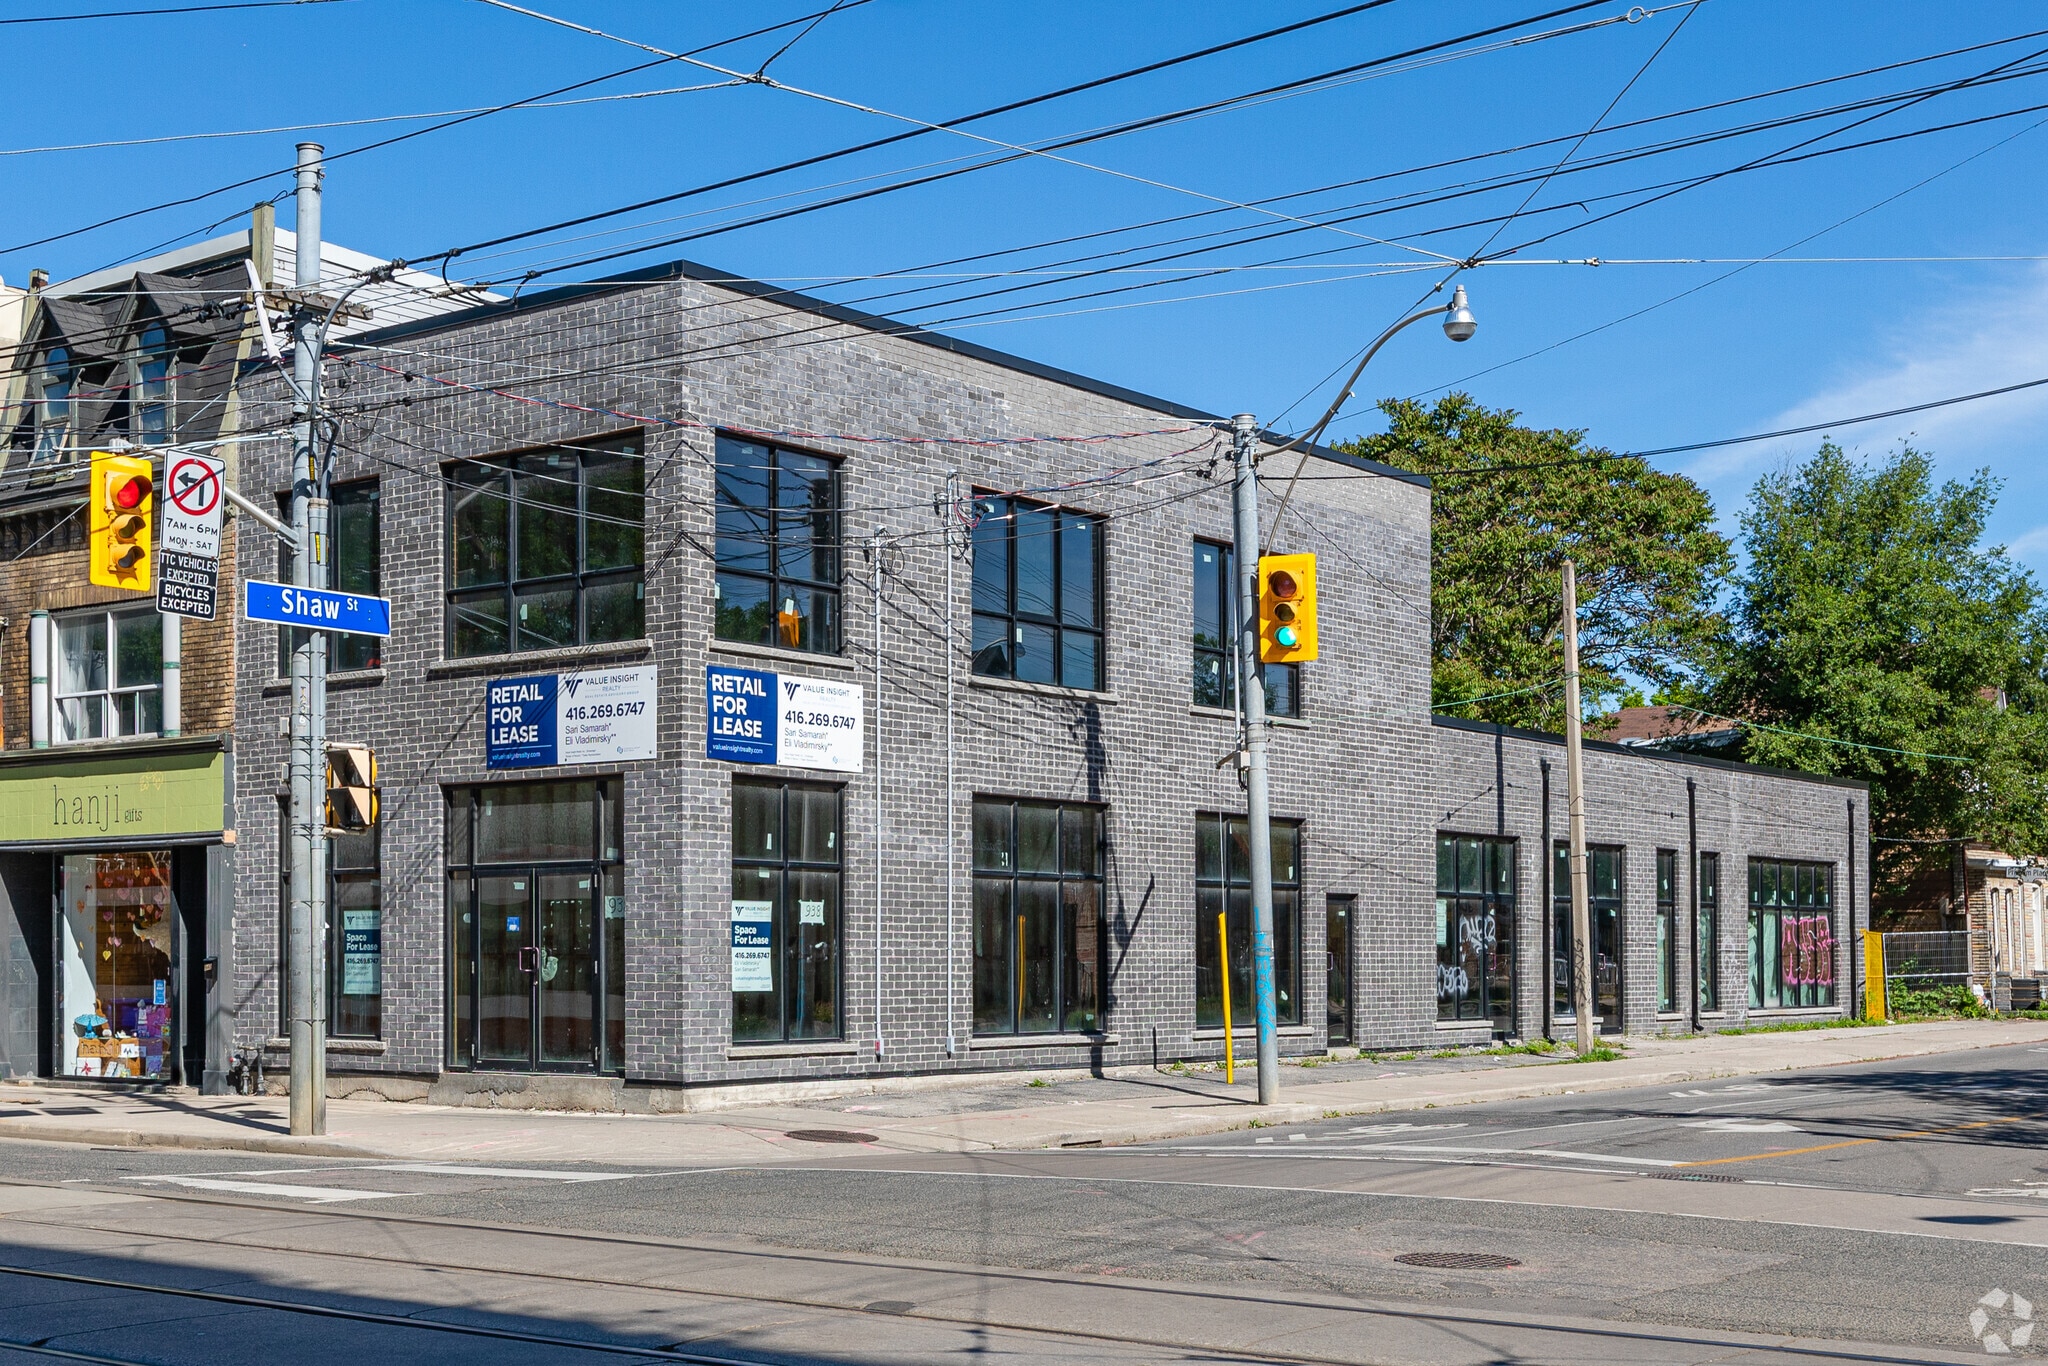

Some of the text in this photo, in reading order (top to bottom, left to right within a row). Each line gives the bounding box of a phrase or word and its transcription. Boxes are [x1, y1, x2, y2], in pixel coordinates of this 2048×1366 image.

[166, 518, 186, 530] 7AM
[197, 524, 218, 536] 6PM
[169, 536, 187, 546] MON
[196, 541, 212, 550] SAT
[160, 553, 217, 573] TTC VEHICLES
[166, 568, 209, 586] EXCEPTED
[165, 584, 209, 601] BICYCLES
[161, 597, 211, 614] EXCEPTED
[282, 588, 358, 620] Shaw St
[586, 673, 639, 685] VALUE INSIGHT
[712, 674, 766, 697] RETAIL
[492, 684, 543, 704] RETAIL
[803, 684, 850, 697] VALUE INSIGHT
[566, 702, 645, 720] 416.269.6747
[713, 695, 747, 715] FOR
[492, 706, 522, 724] FOR
[785, 710, 856, 729] 416.269.6747
[492, 725, 538, 745] LEASE
[714, 716, 762, 738] LEASE
[54, 784, 142, 832] hanji gifts
[609, 898, 624, 913] 93
[805, 905, 821, 917] 938
[346, 934, 367, 943] Space
[734, 925, 757, 935] Space
[734, 936, 768, 944] For Lease
